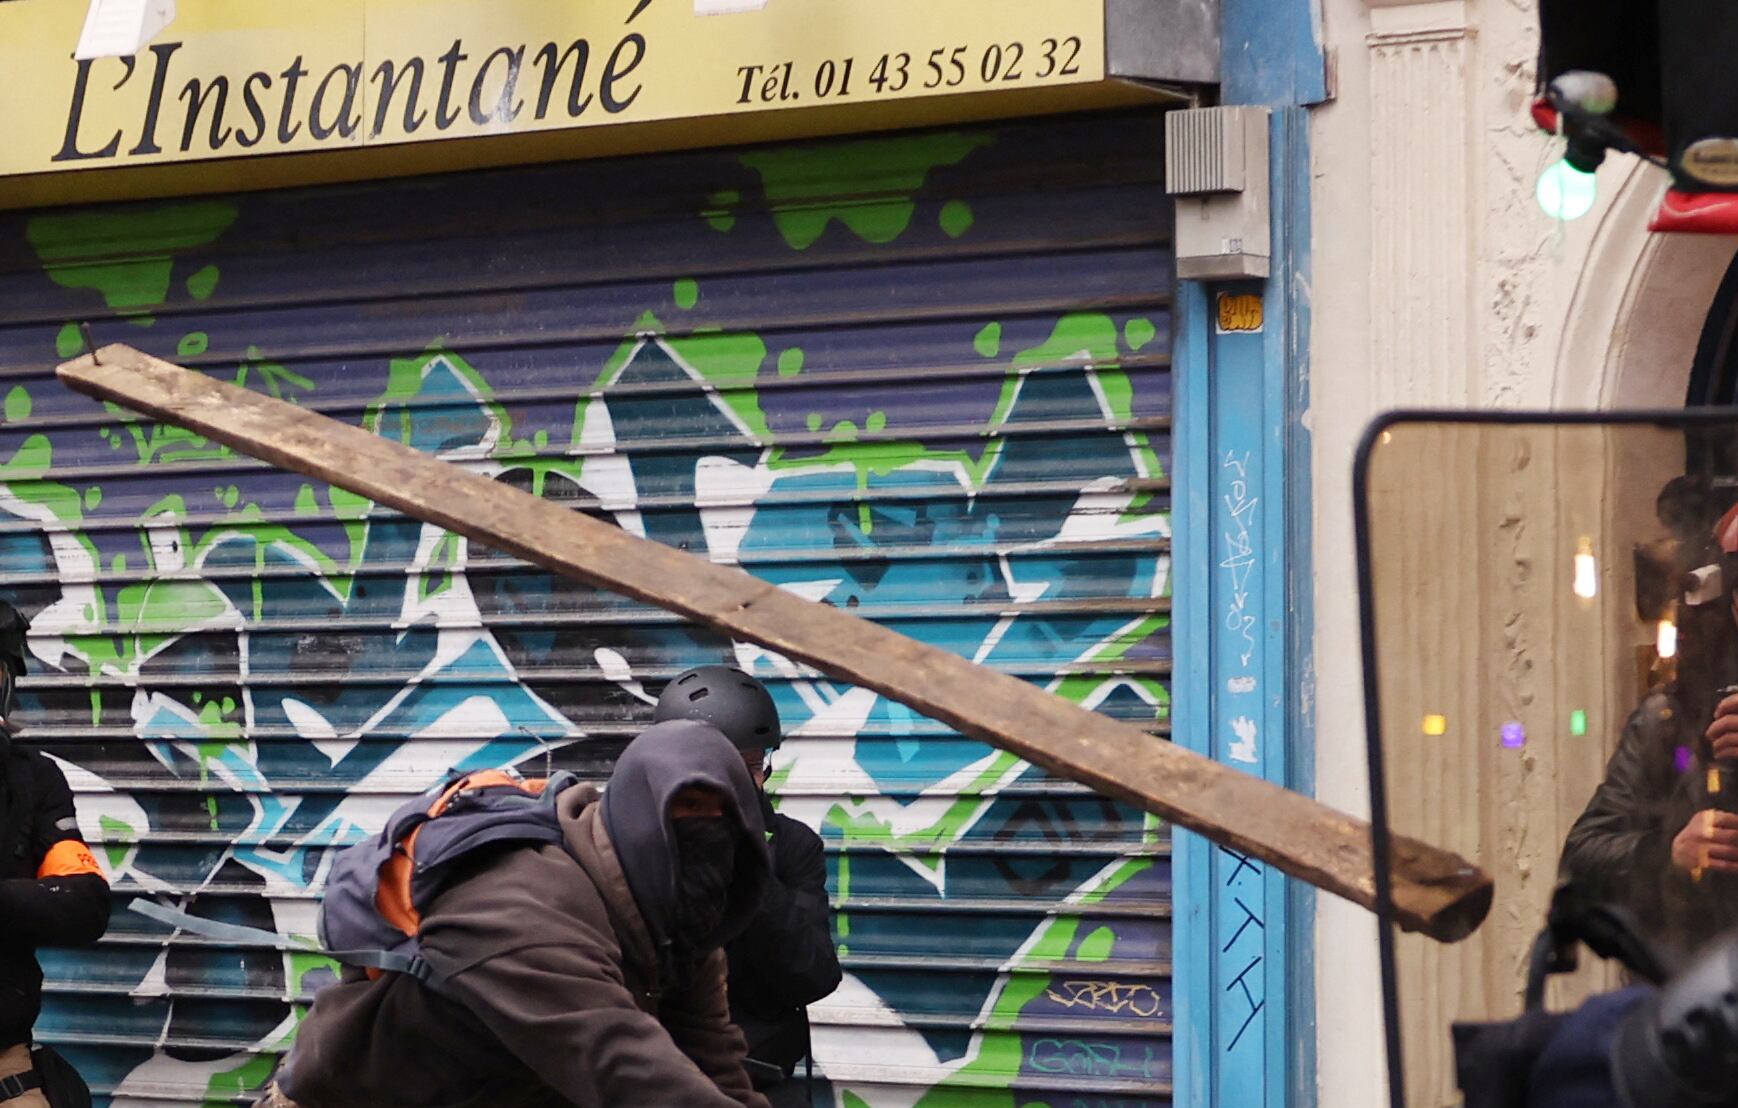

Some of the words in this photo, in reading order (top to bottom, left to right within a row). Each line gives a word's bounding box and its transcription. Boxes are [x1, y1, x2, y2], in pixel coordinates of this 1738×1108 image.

[51, 0, 651, 162] L'Instantané
[736, 61, 800, 103] Tél.
[814, 57, 854, 97] 01
[868, 52, 911, 93] 43
[924, 45, 968, 88] 55
[980, 42, 1024, 83] 02
[1035, 36, 1082, 78] 32
